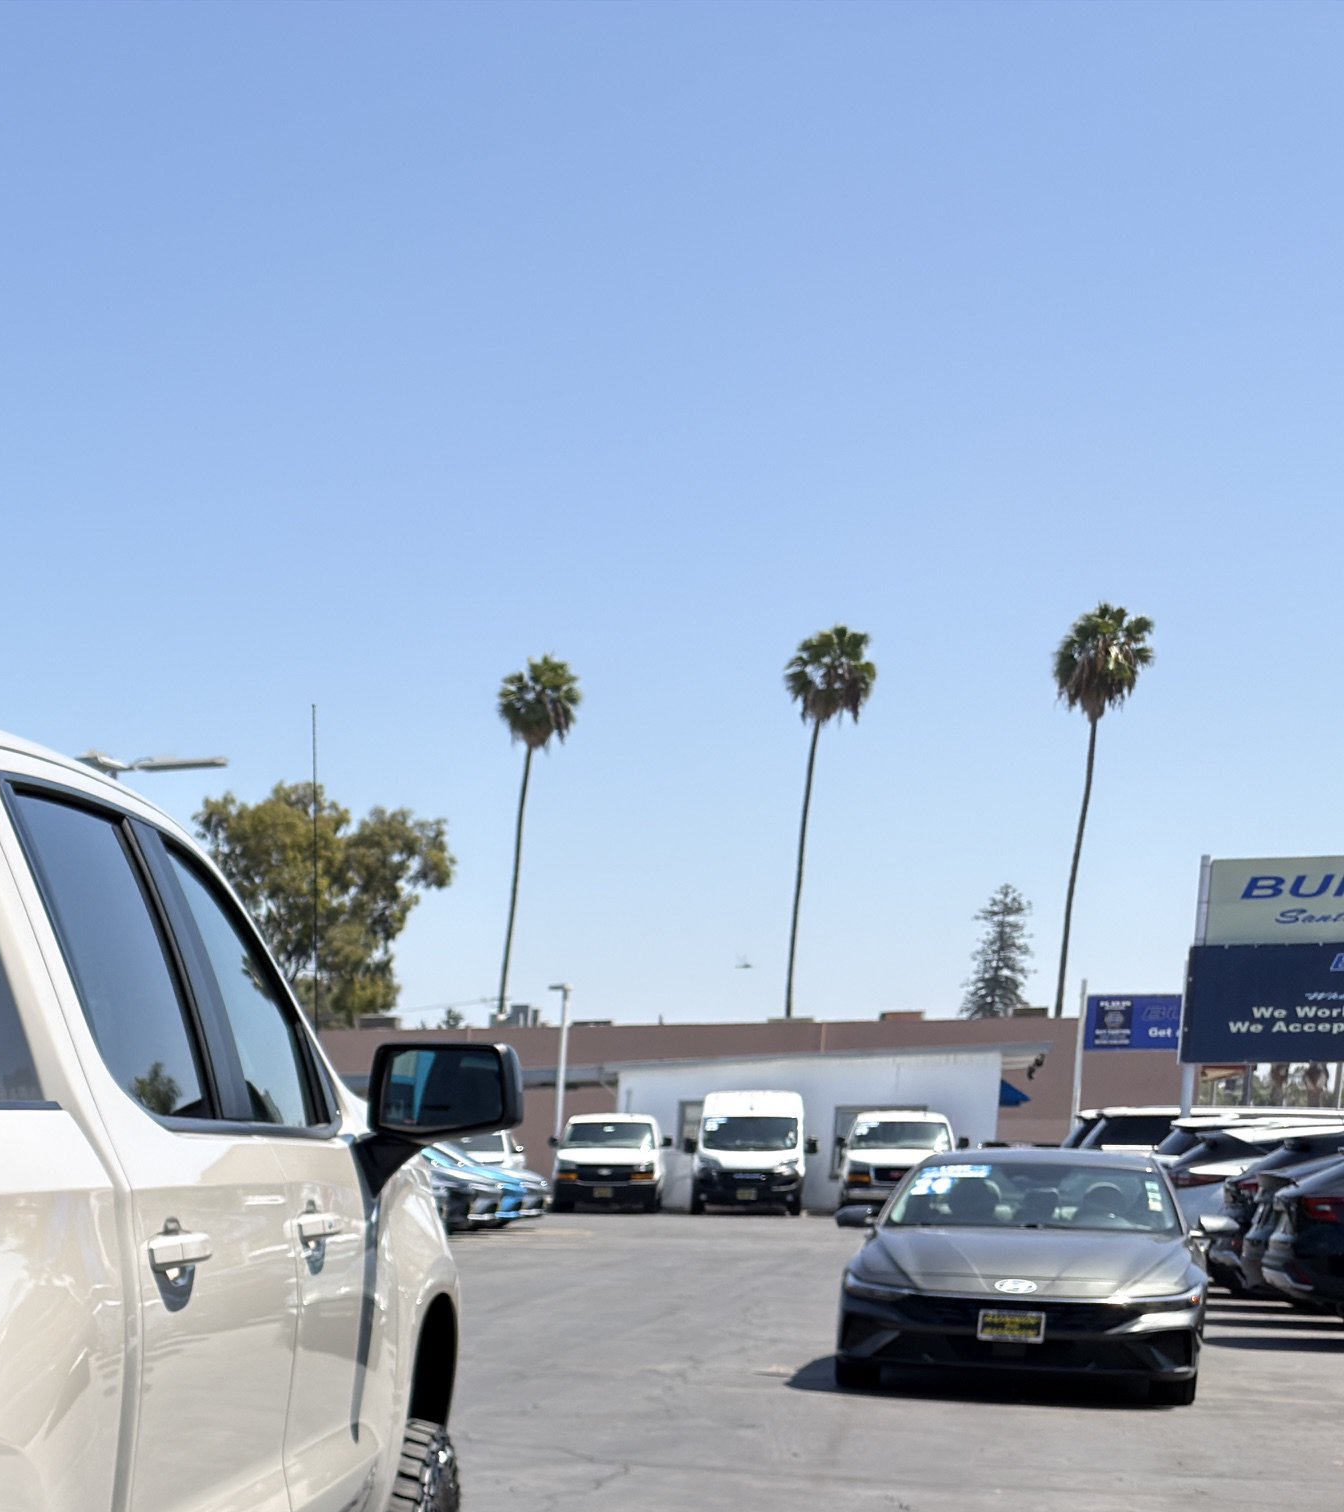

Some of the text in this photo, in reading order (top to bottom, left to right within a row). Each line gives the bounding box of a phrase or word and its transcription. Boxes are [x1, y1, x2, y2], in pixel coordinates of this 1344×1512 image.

[1252, 1006, 1344, 1018] We Wor
[1229, 1021, 1263, 1033] We
